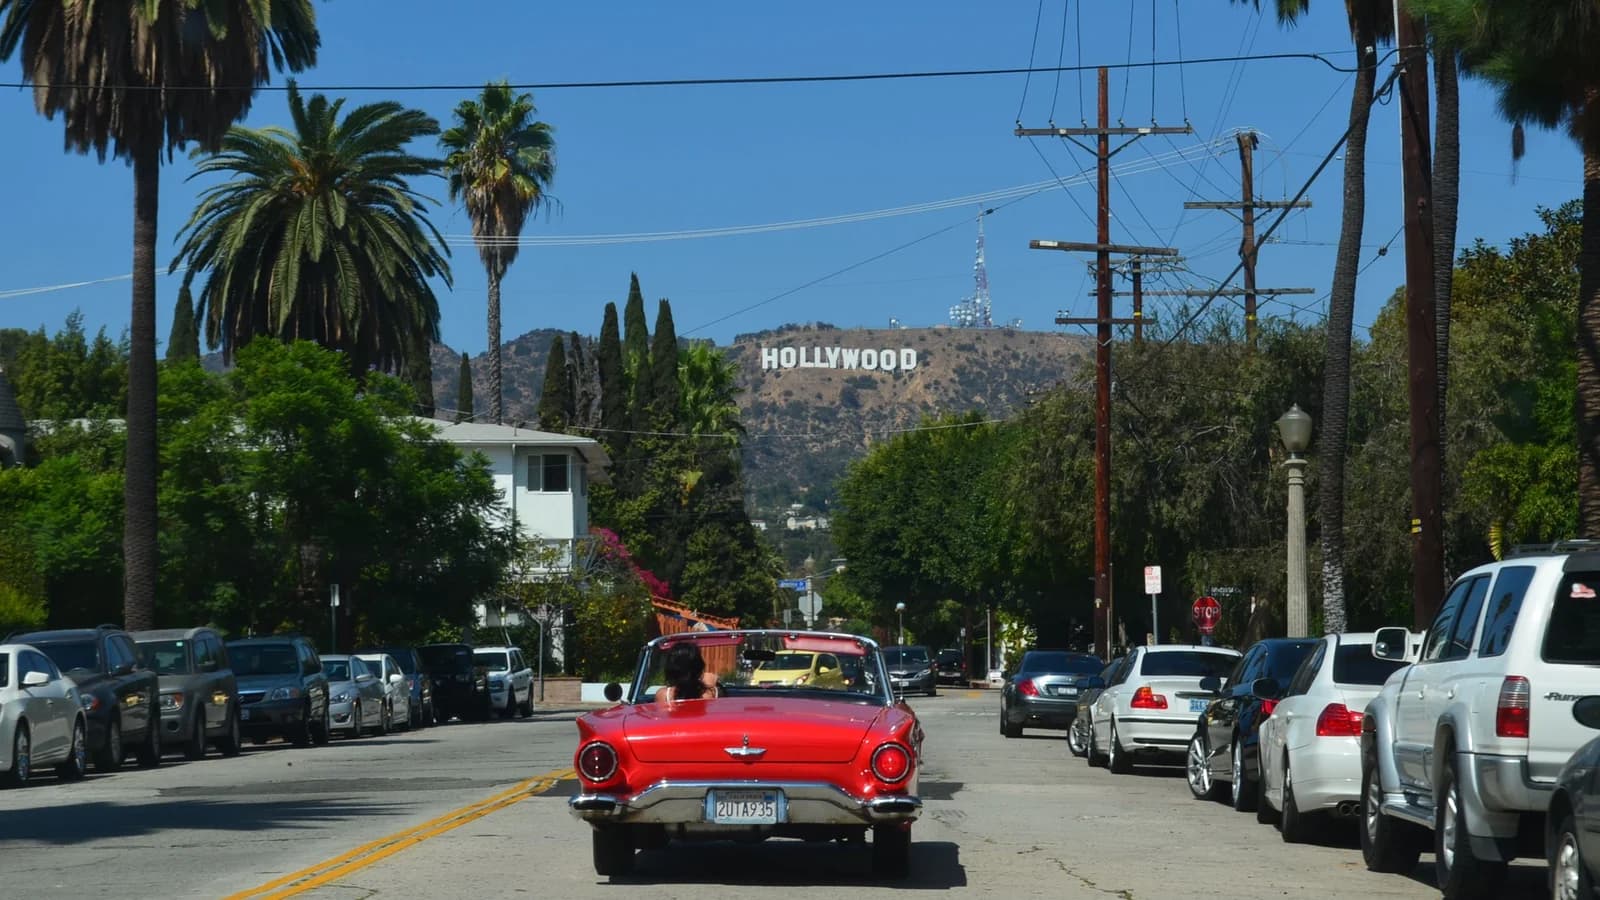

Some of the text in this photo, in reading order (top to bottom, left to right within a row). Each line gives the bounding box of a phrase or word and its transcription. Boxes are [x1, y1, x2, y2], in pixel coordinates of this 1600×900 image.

[761, 346, 917, 371] HOLLYWOOD
[1193, 606, 1219, 618] STOP
[718, 801, 773, 817] 2UTA935
